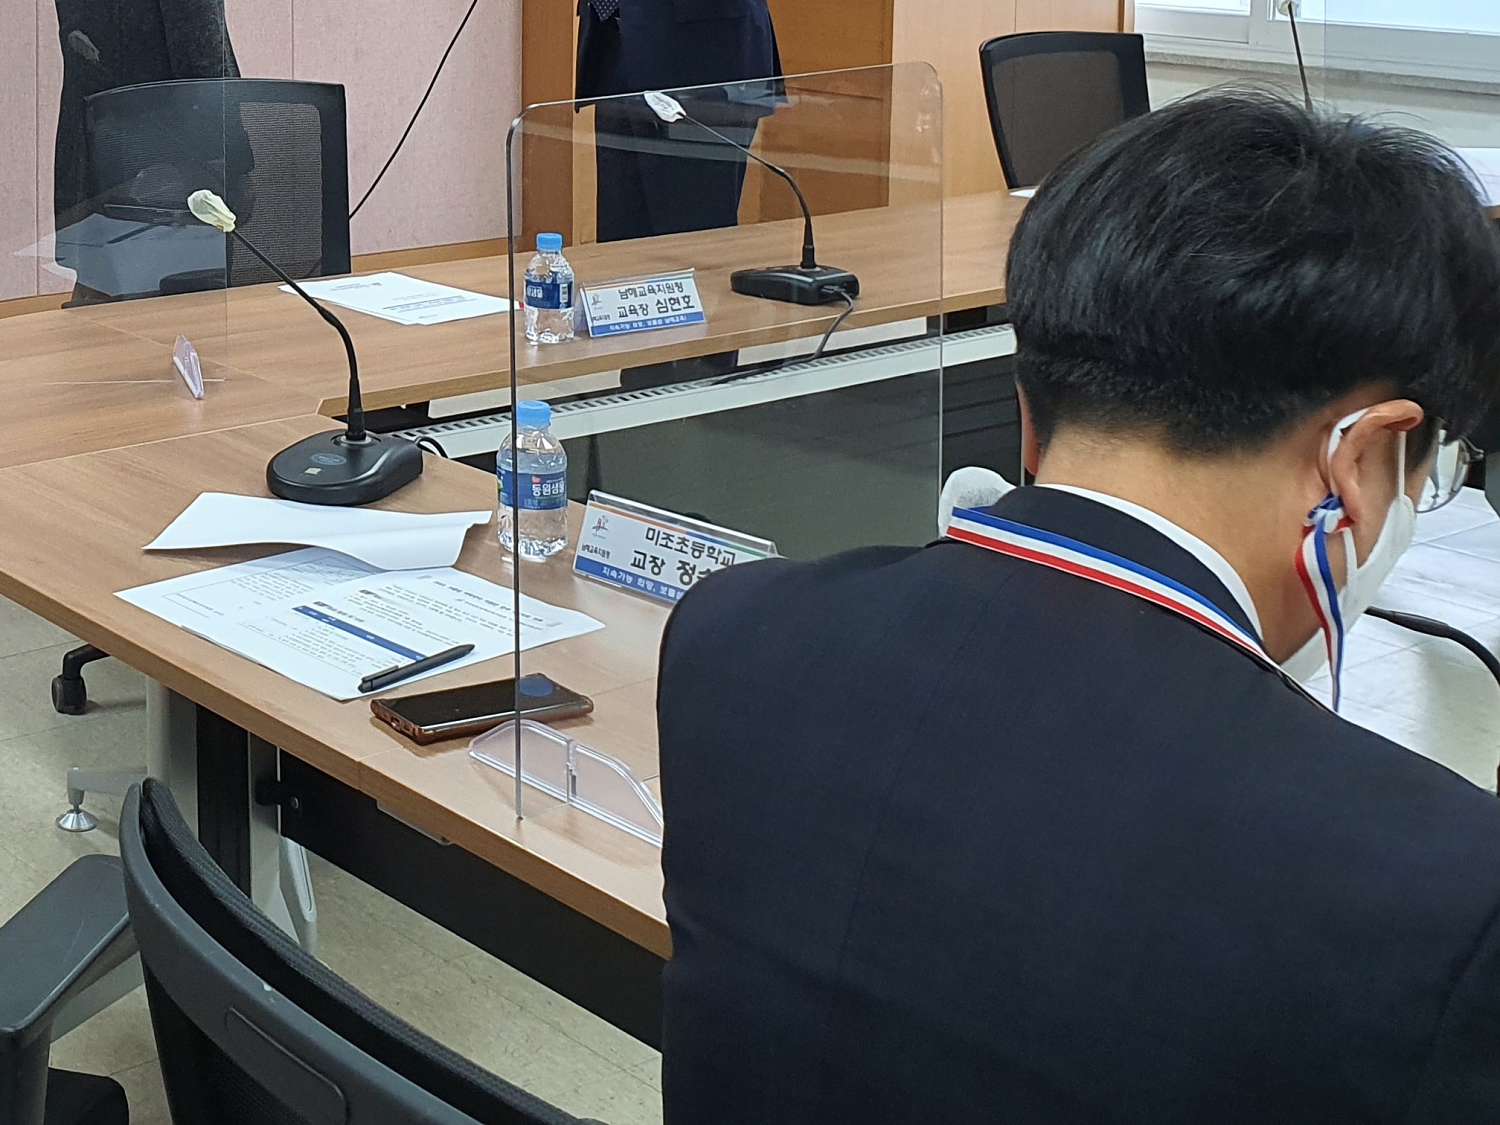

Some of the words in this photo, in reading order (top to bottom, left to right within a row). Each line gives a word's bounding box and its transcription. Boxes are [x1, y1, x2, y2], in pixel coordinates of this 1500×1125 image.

[618, 282, 683, 299] 남해교육지원청
[617, 303, 649, 319] 교육장
[655, 295, 695, 314] 심현호
[645, 526, 737, 566] 미조초등학교
[630, 549, 666, 576] 교장
